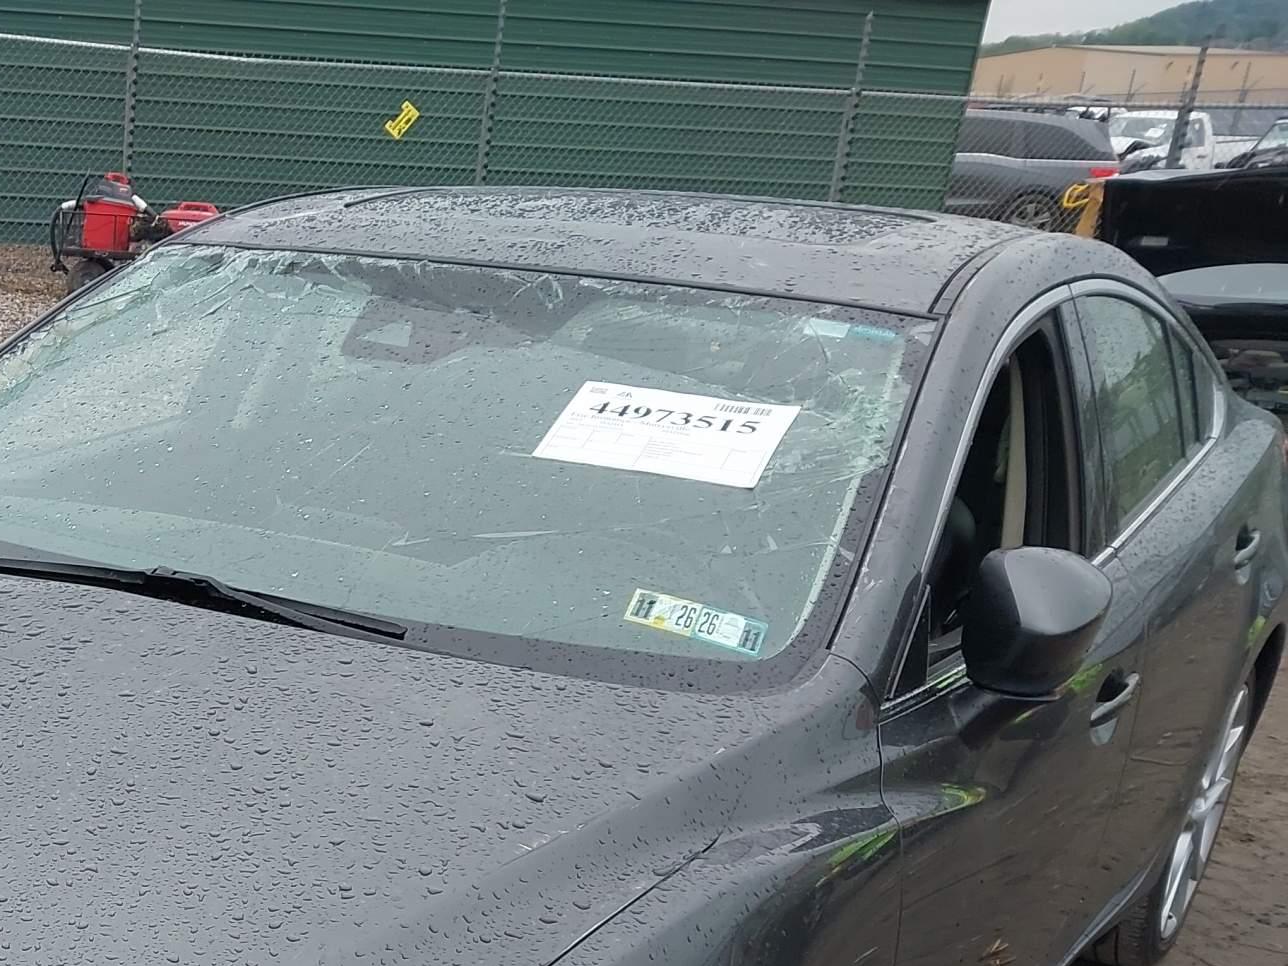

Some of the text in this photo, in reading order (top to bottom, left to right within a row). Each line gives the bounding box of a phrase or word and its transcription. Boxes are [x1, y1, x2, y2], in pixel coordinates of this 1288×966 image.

[590, 402, 759, 433] 44973515
[675, 605, 697, 629] 26
[699, 612, 761, 652] 26 11
